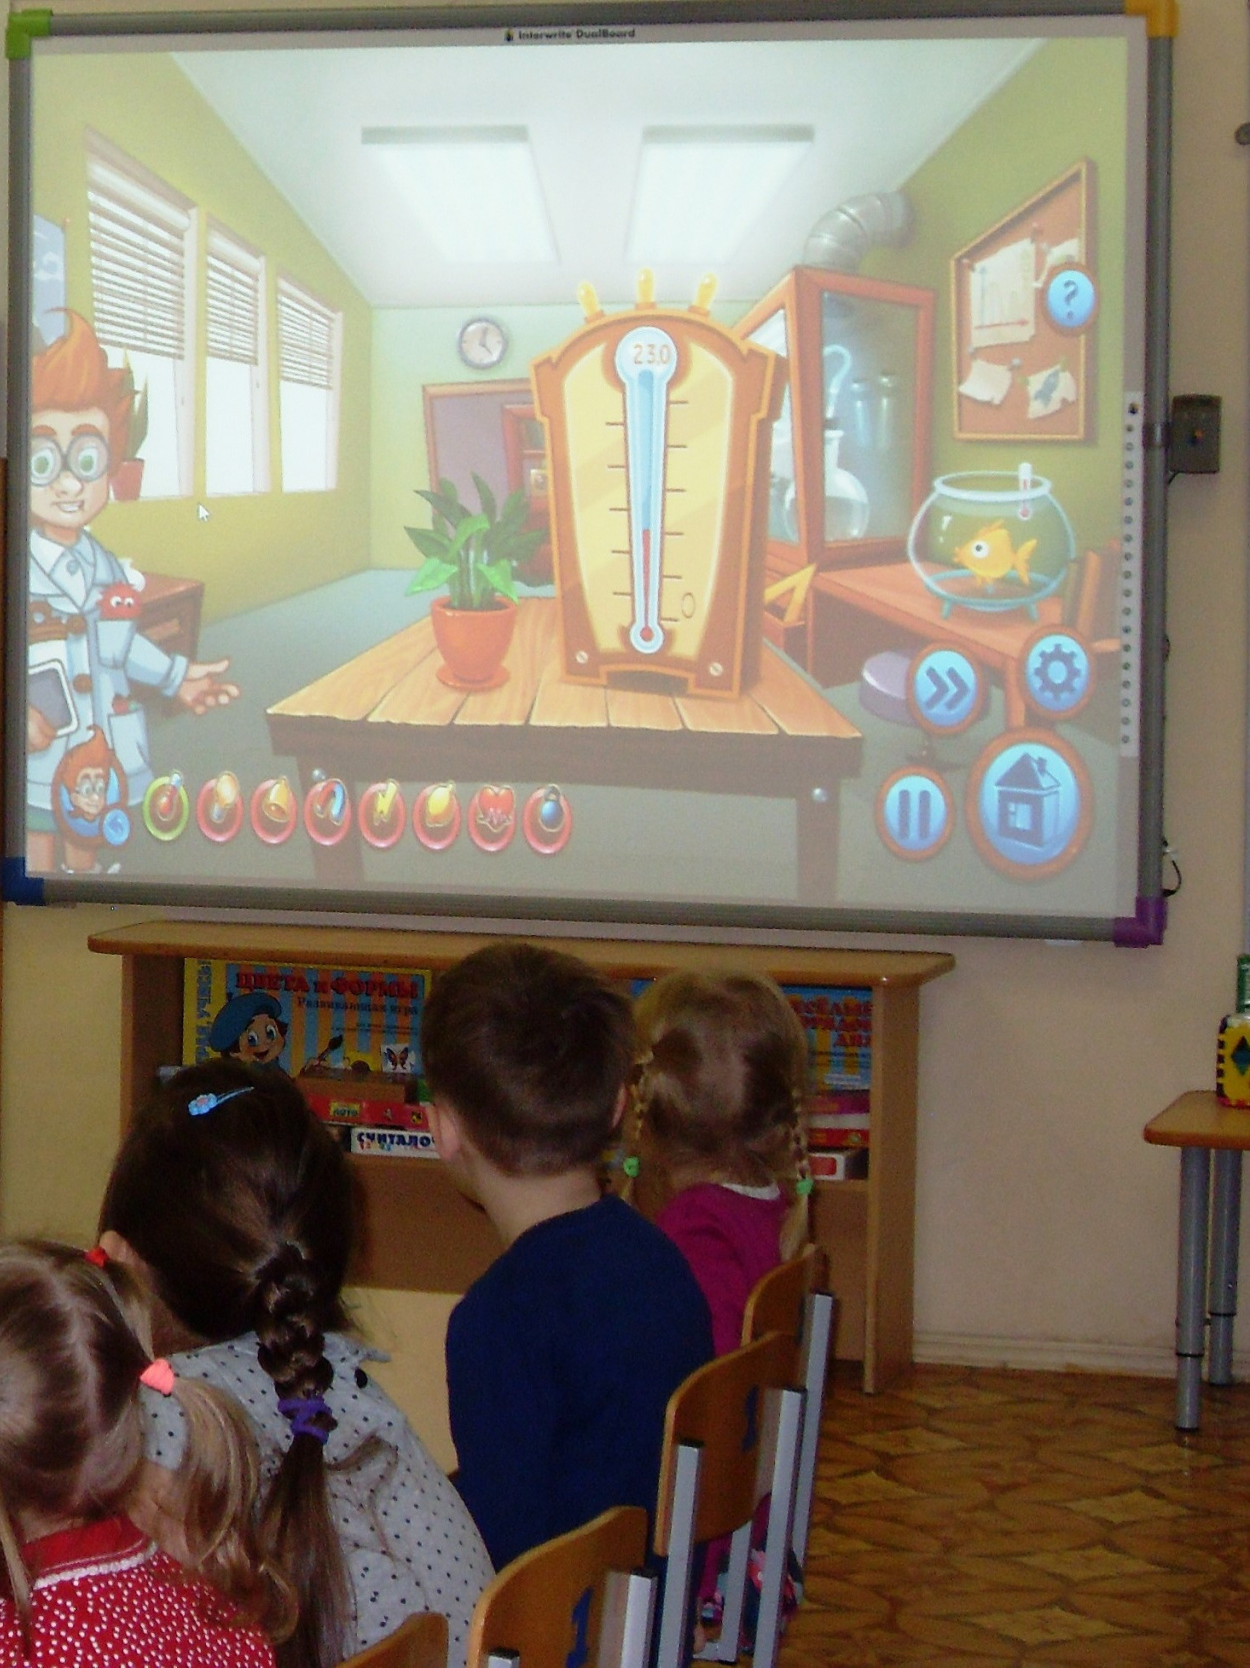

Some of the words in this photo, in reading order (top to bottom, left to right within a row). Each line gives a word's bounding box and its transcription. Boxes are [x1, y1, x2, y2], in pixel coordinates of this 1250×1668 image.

[518, 30, 572, 40] Interwrite
[576, 28, 636, 39] DualBoard
[237, 972, 309, 992] ЦВЕТА
[330, 977, 419, 999] ФОРМЫ
[357, 1132, 436, 1148] СЧИТАЛО
